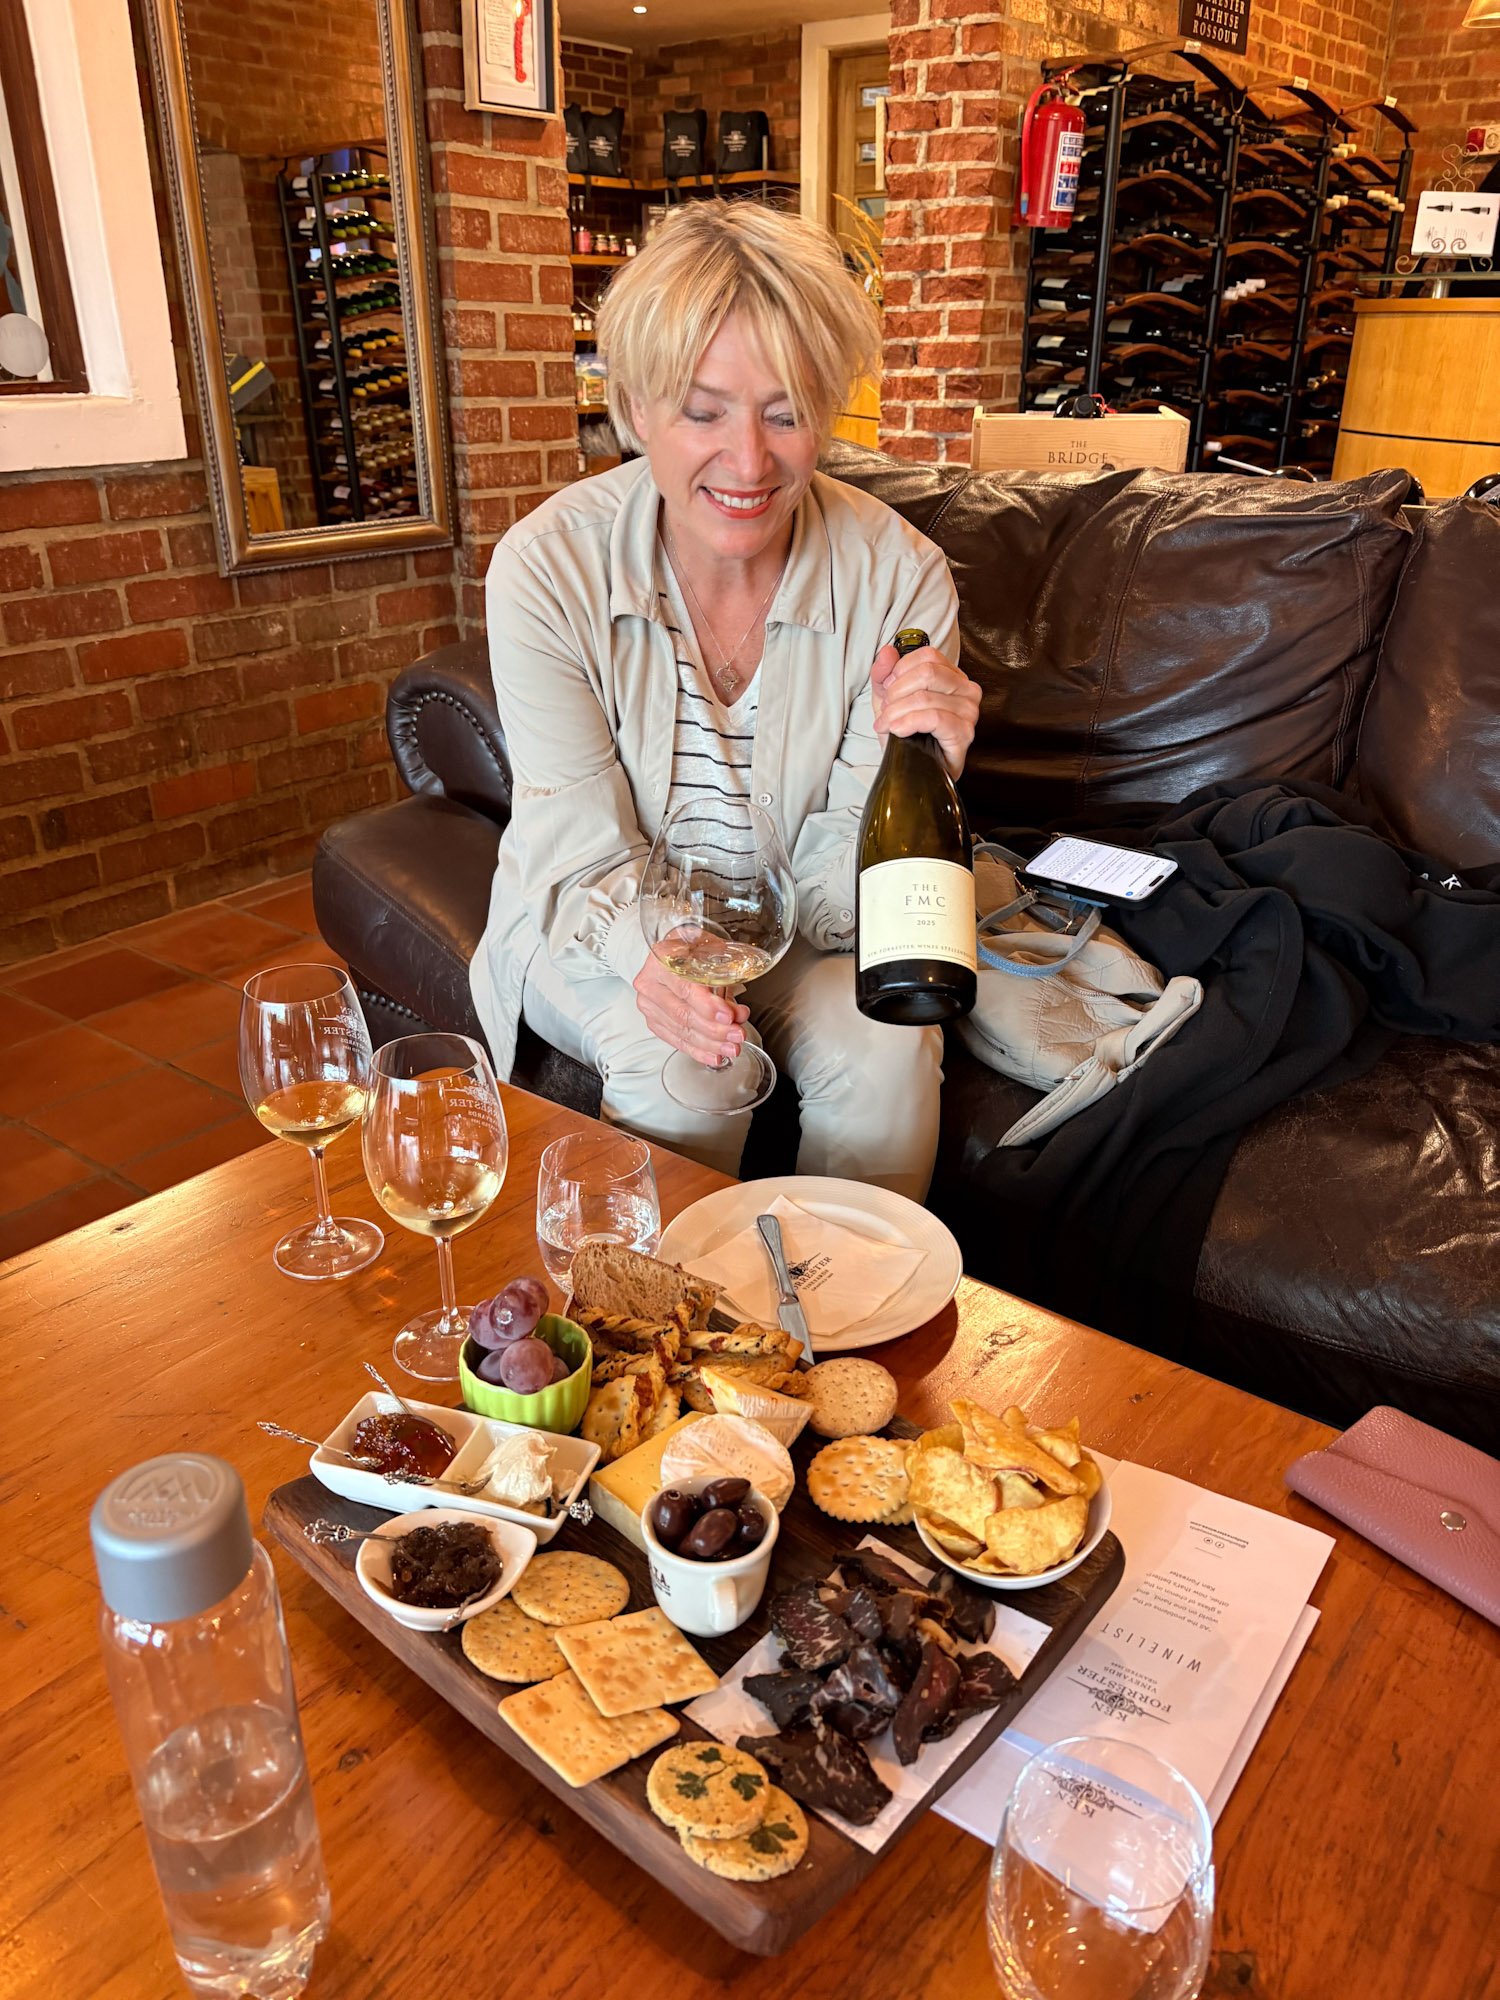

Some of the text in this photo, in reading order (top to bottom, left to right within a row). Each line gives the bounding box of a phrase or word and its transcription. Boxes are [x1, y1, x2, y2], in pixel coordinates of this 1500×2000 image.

[1195, 2, 1239, 29] MATHYSE
[1192, 19, 1238, 46] ROSSOUW
[1070, 440, 1088, 449] THE
[912, 883, 939, 893] THE
[905, 895, 947, 908] FMC
[916, 919, 937, 927] 2025
[793, 1256, 833, 1291] ORRESTER
[1168, 1570, 1216, 1592] Ken Forrester
[1135, 1587, 1150, 1596] and
[1163, 1588, 1187, 1602] chenin
[1152, 1604, 1185, 1621] problems
[1196, 1600, 1216, 1613] glass
[1197, 1612, 1218, 1625] world
[1100, 1621, 1202, 1672] WINELIST
[1077, 1665, 1172, 1712] FORRESTER
[1103, 1666, 1157, 1694] VINEYARDS
[1090, 1700, 1128, 1722] KEN
[1056, 1790, 1097, 1818] KEN
